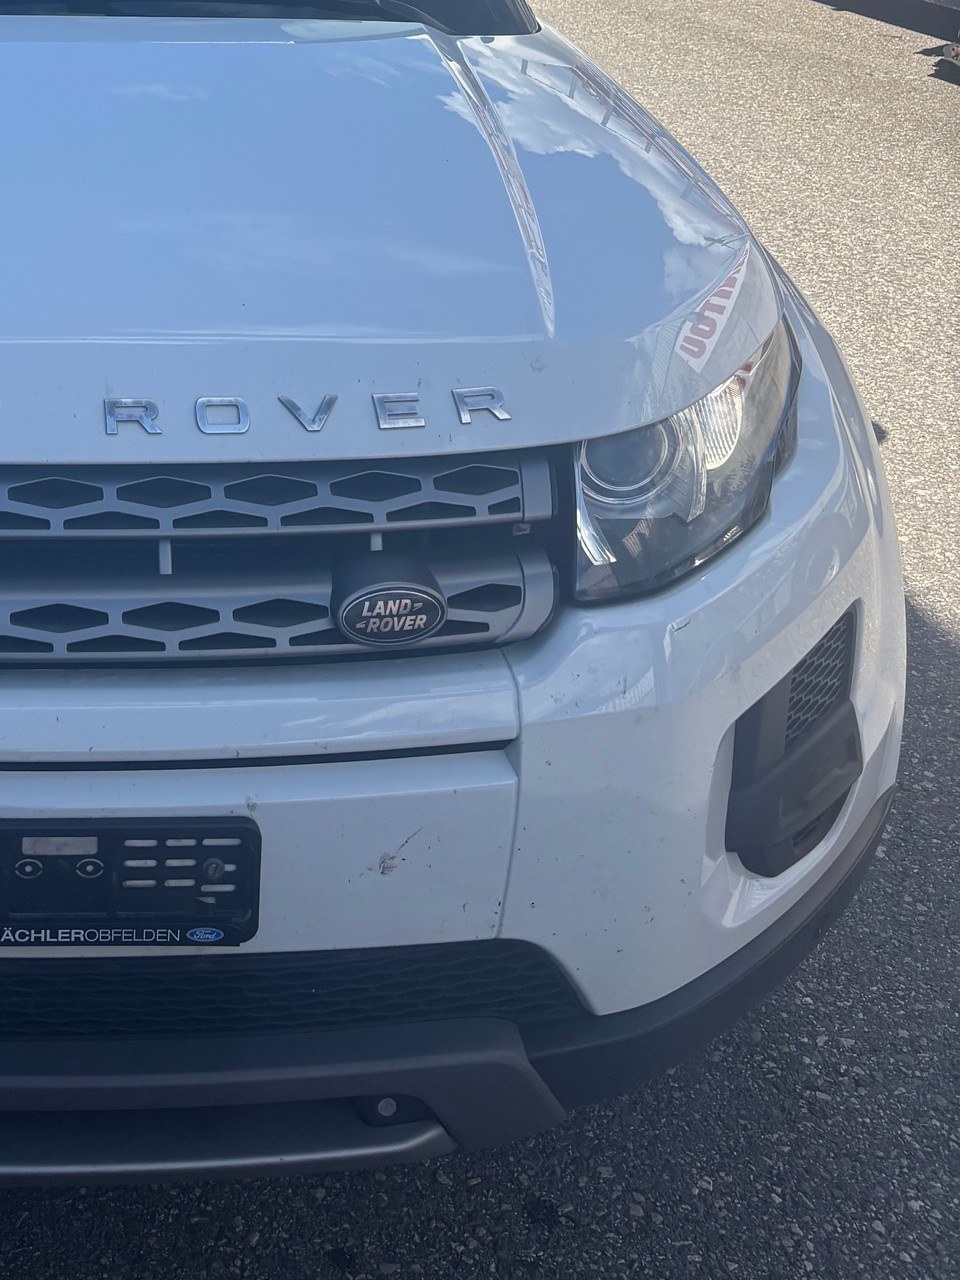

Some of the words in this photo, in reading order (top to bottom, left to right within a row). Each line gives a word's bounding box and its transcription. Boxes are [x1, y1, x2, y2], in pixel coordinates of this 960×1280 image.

[104, 386, 512, 434] ROVER
[361, 599, 412, 617] LAND
[366, 614, 428, 633] ROVER
